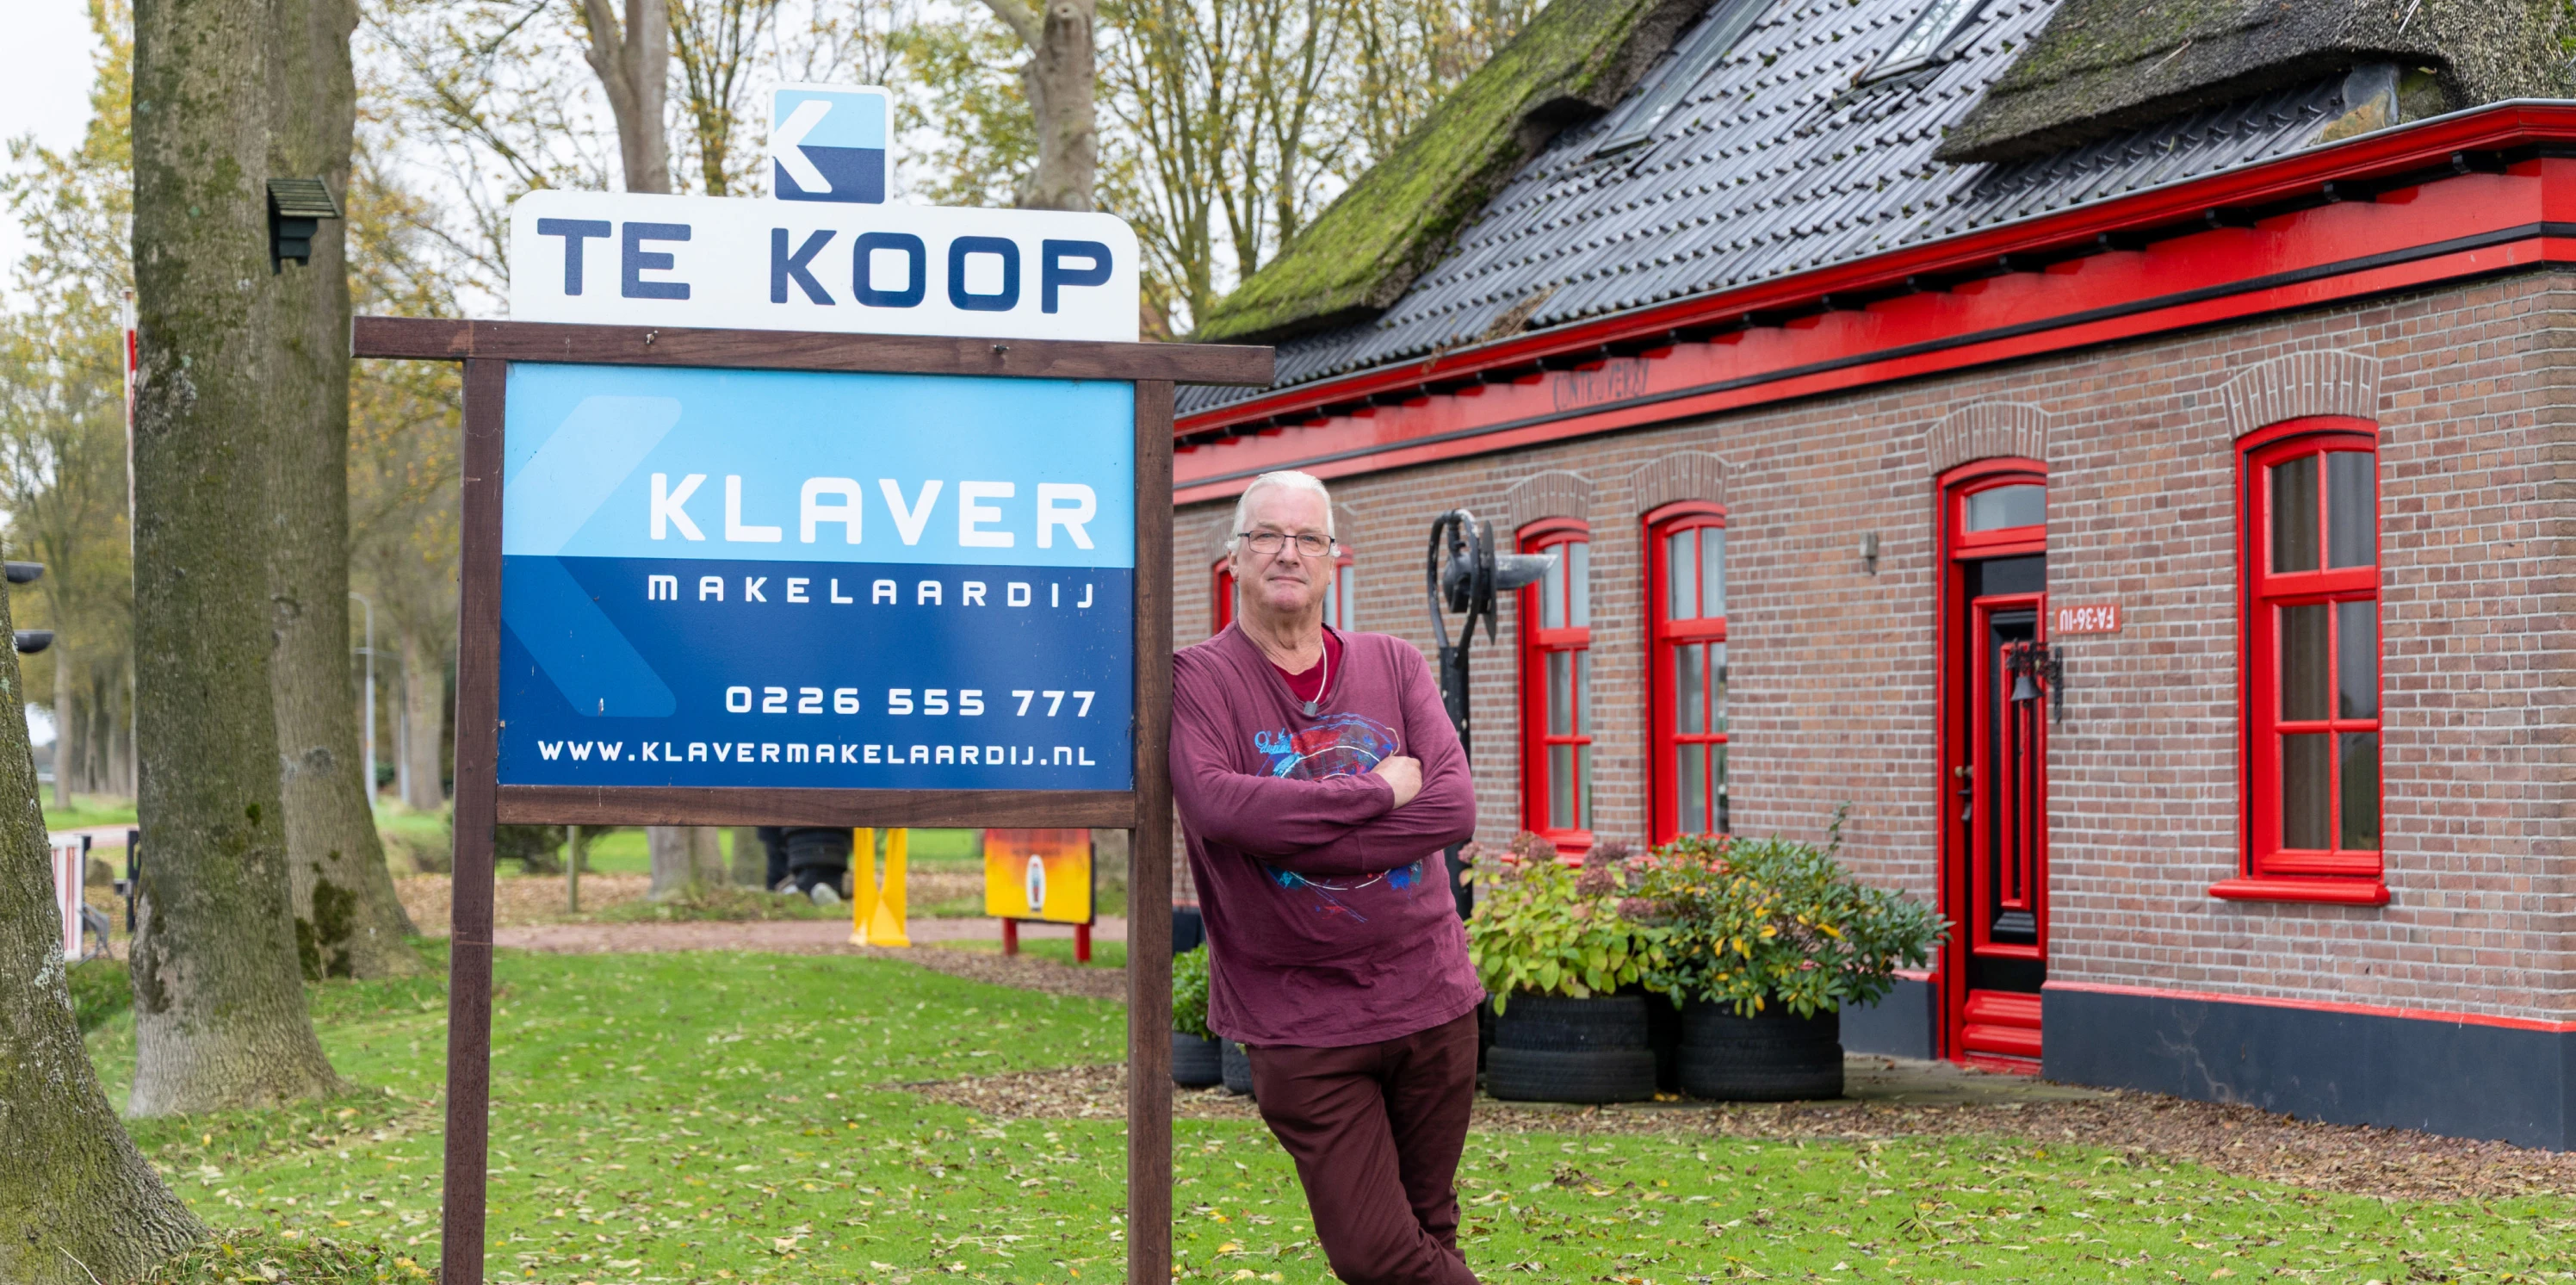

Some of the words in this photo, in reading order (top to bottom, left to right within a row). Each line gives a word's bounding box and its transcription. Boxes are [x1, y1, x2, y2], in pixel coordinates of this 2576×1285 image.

[537, 218, 691, 301] TE
[771, 227, 1113, 315] KOOP
[650, 472, 1098, 550] KLAVER
[647, 574, 1094, 609] MAKELAARDIJ
[726, 686, 861, 716] 0226
[889, 688, 986, 717] 555
[1012, 690, 1096, 718] 777
